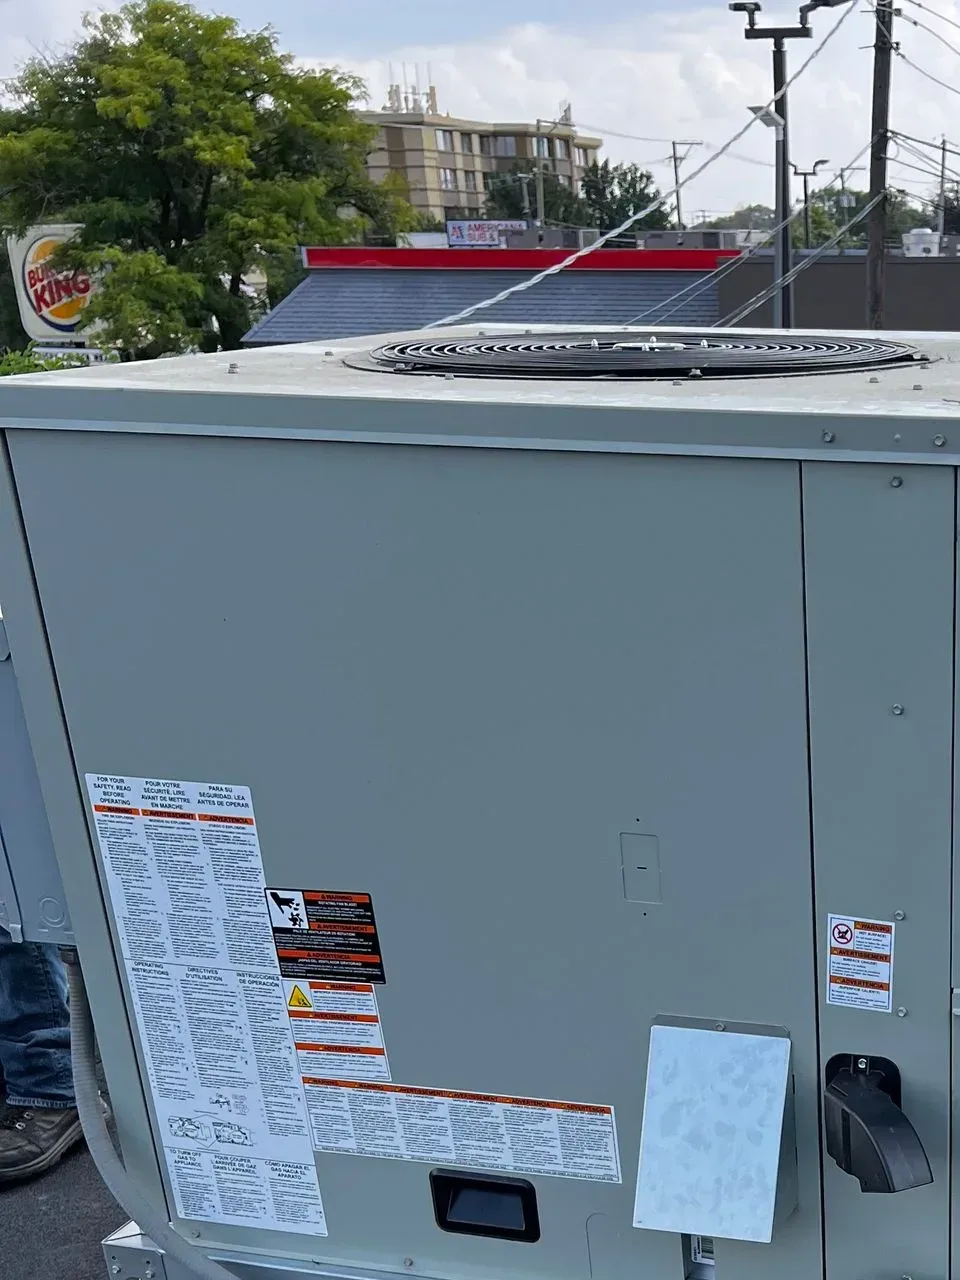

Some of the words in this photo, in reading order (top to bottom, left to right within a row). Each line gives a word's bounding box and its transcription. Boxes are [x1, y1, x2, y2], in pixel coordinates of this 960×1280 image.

[33, 273, 91, 315] KING
[100, 797, 130, 805] OPERATING
[134, 961, 163, 969] OPERATING
[132, 968, 169, 976] INSTRUCTIONS
[188, 967, 218, 975] DIRECTIVES
[186, 974, 222, 982] D'UTILISATION
[237, 973, 280, 981] INSTRUCCIONES
[174, 1159, 201, 1167] APPLIANCE
[281, 1162, 303, 1170] APAGAR
[278, 1172, 301, 1180] APARATO
